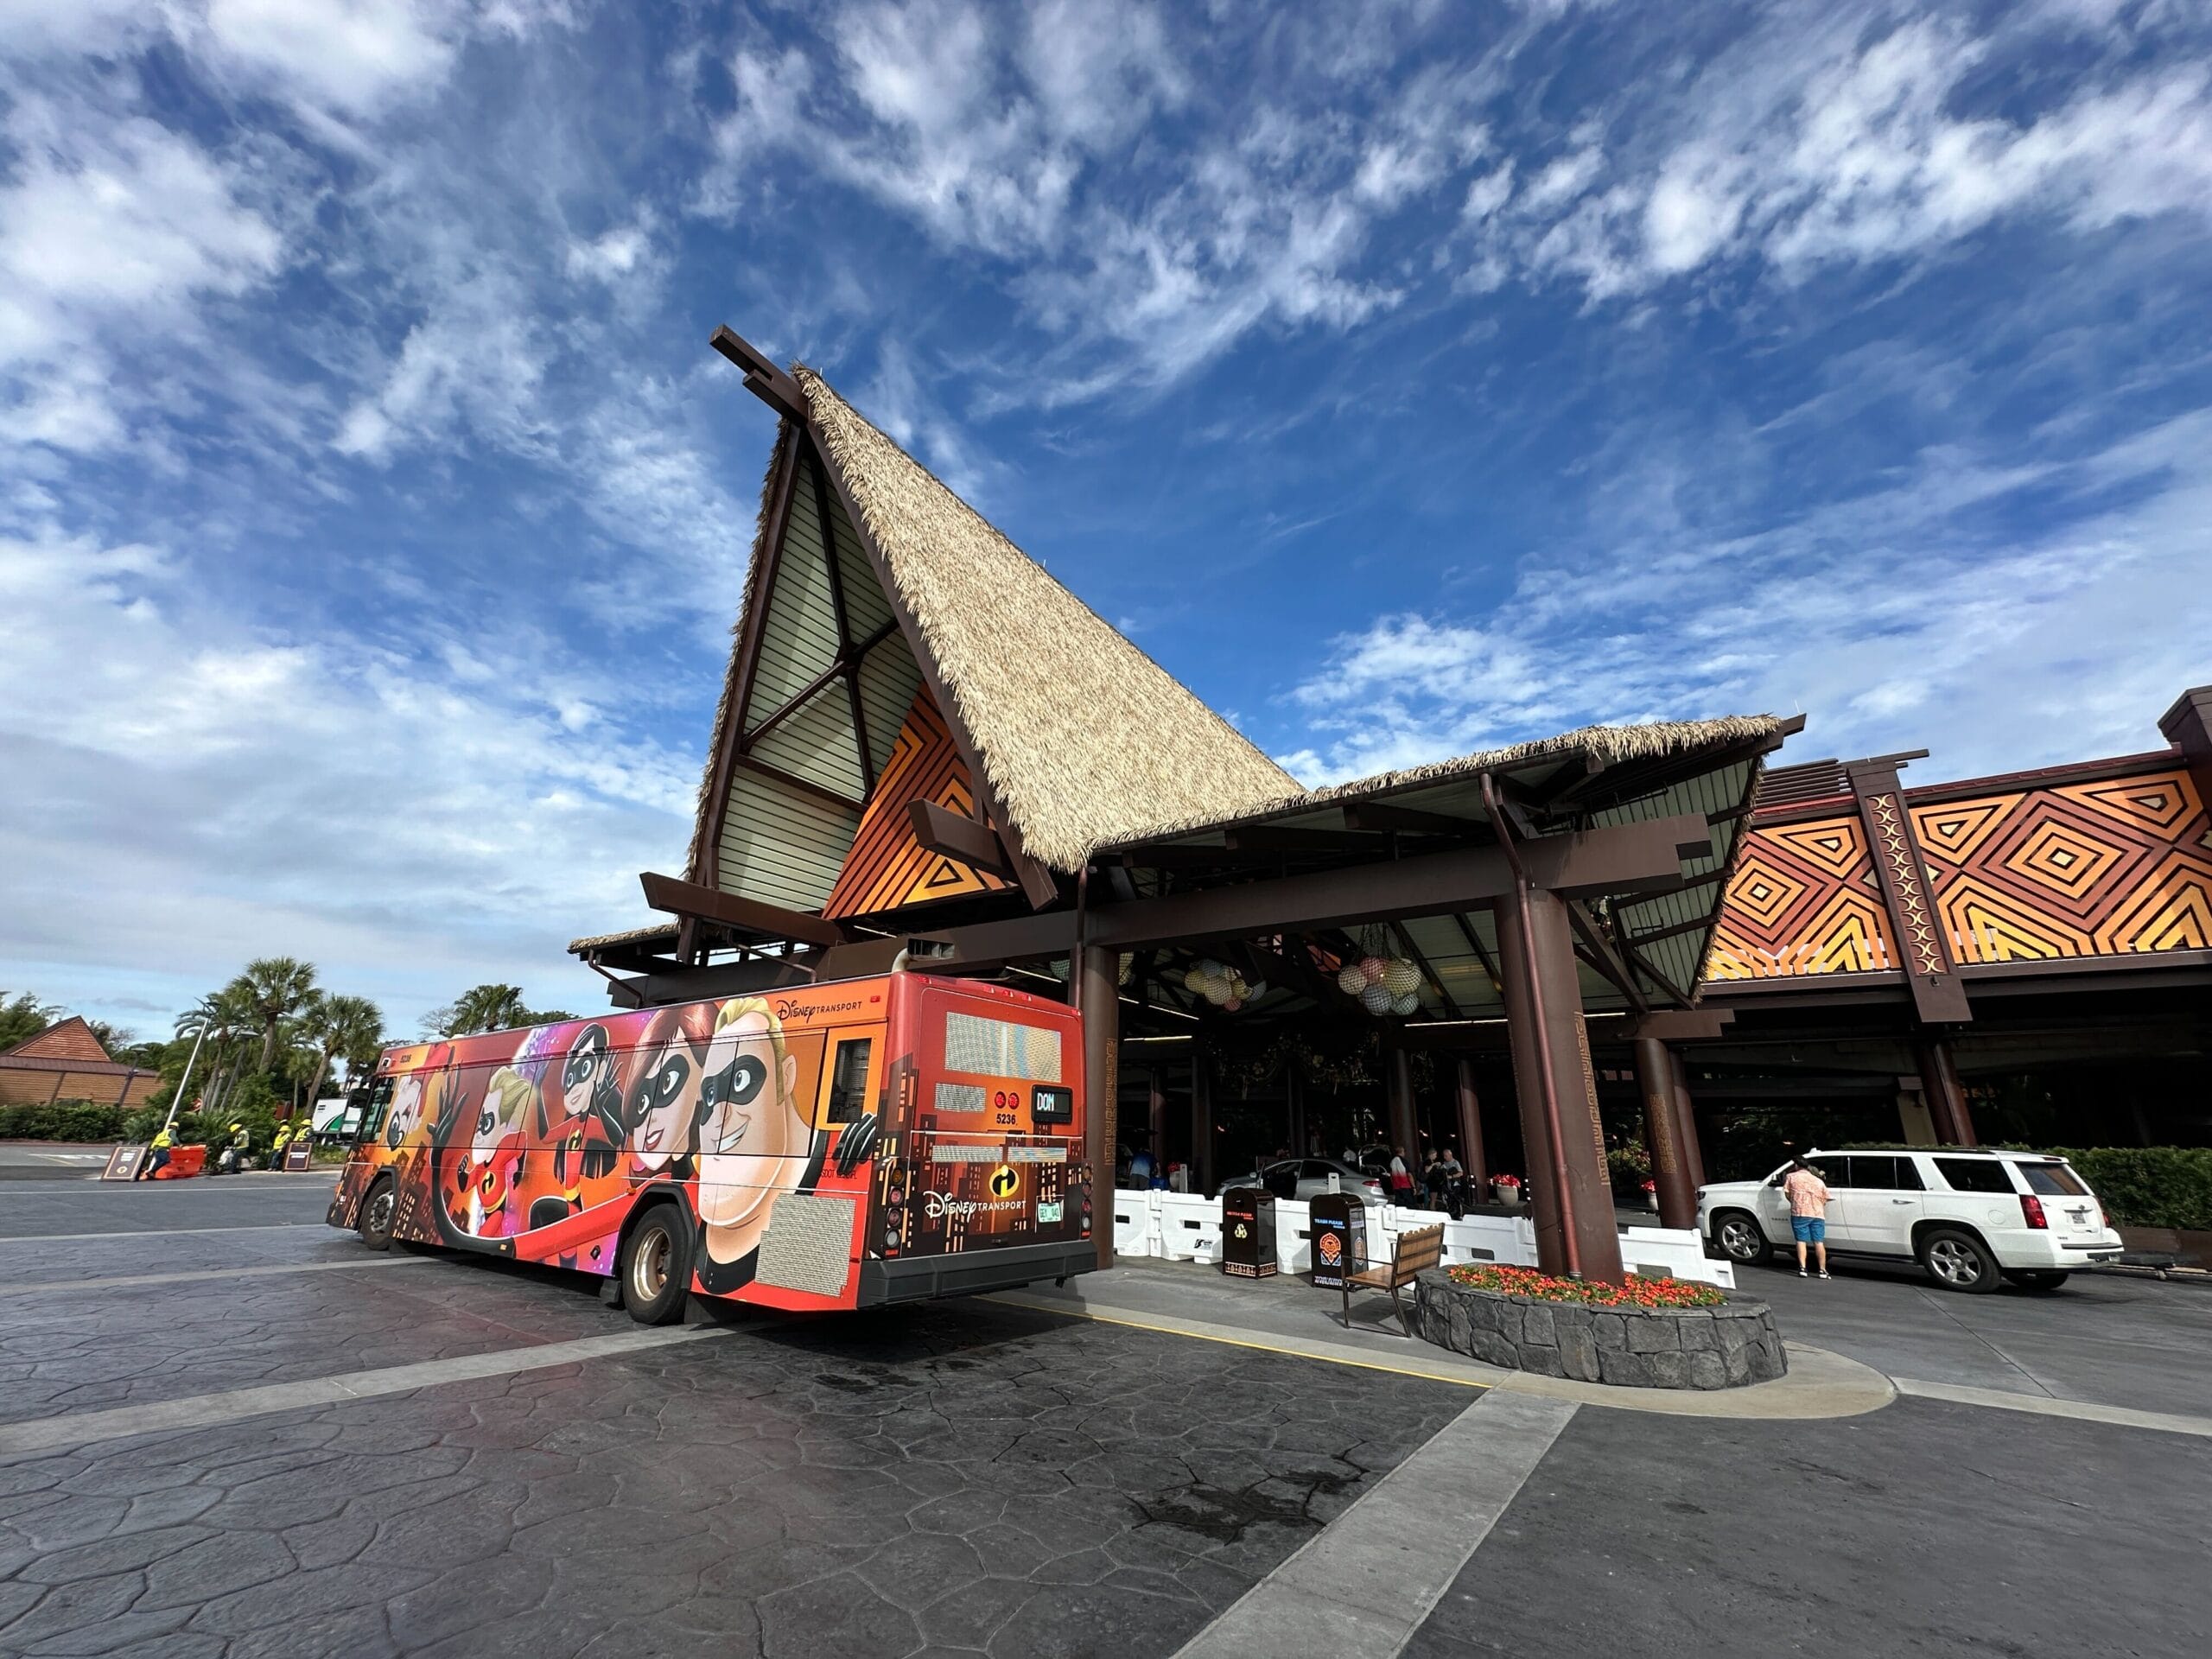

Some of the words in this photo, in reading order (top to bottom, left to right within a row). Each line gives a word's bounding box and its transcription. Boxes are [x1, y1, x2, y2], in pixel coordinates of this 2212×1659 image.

[816, 1001, 862, 1014] TRANSPORT
[996, 1113, 1016, 1125] 5236
[977, 1200, 1027, 1211] TRANSPORT
